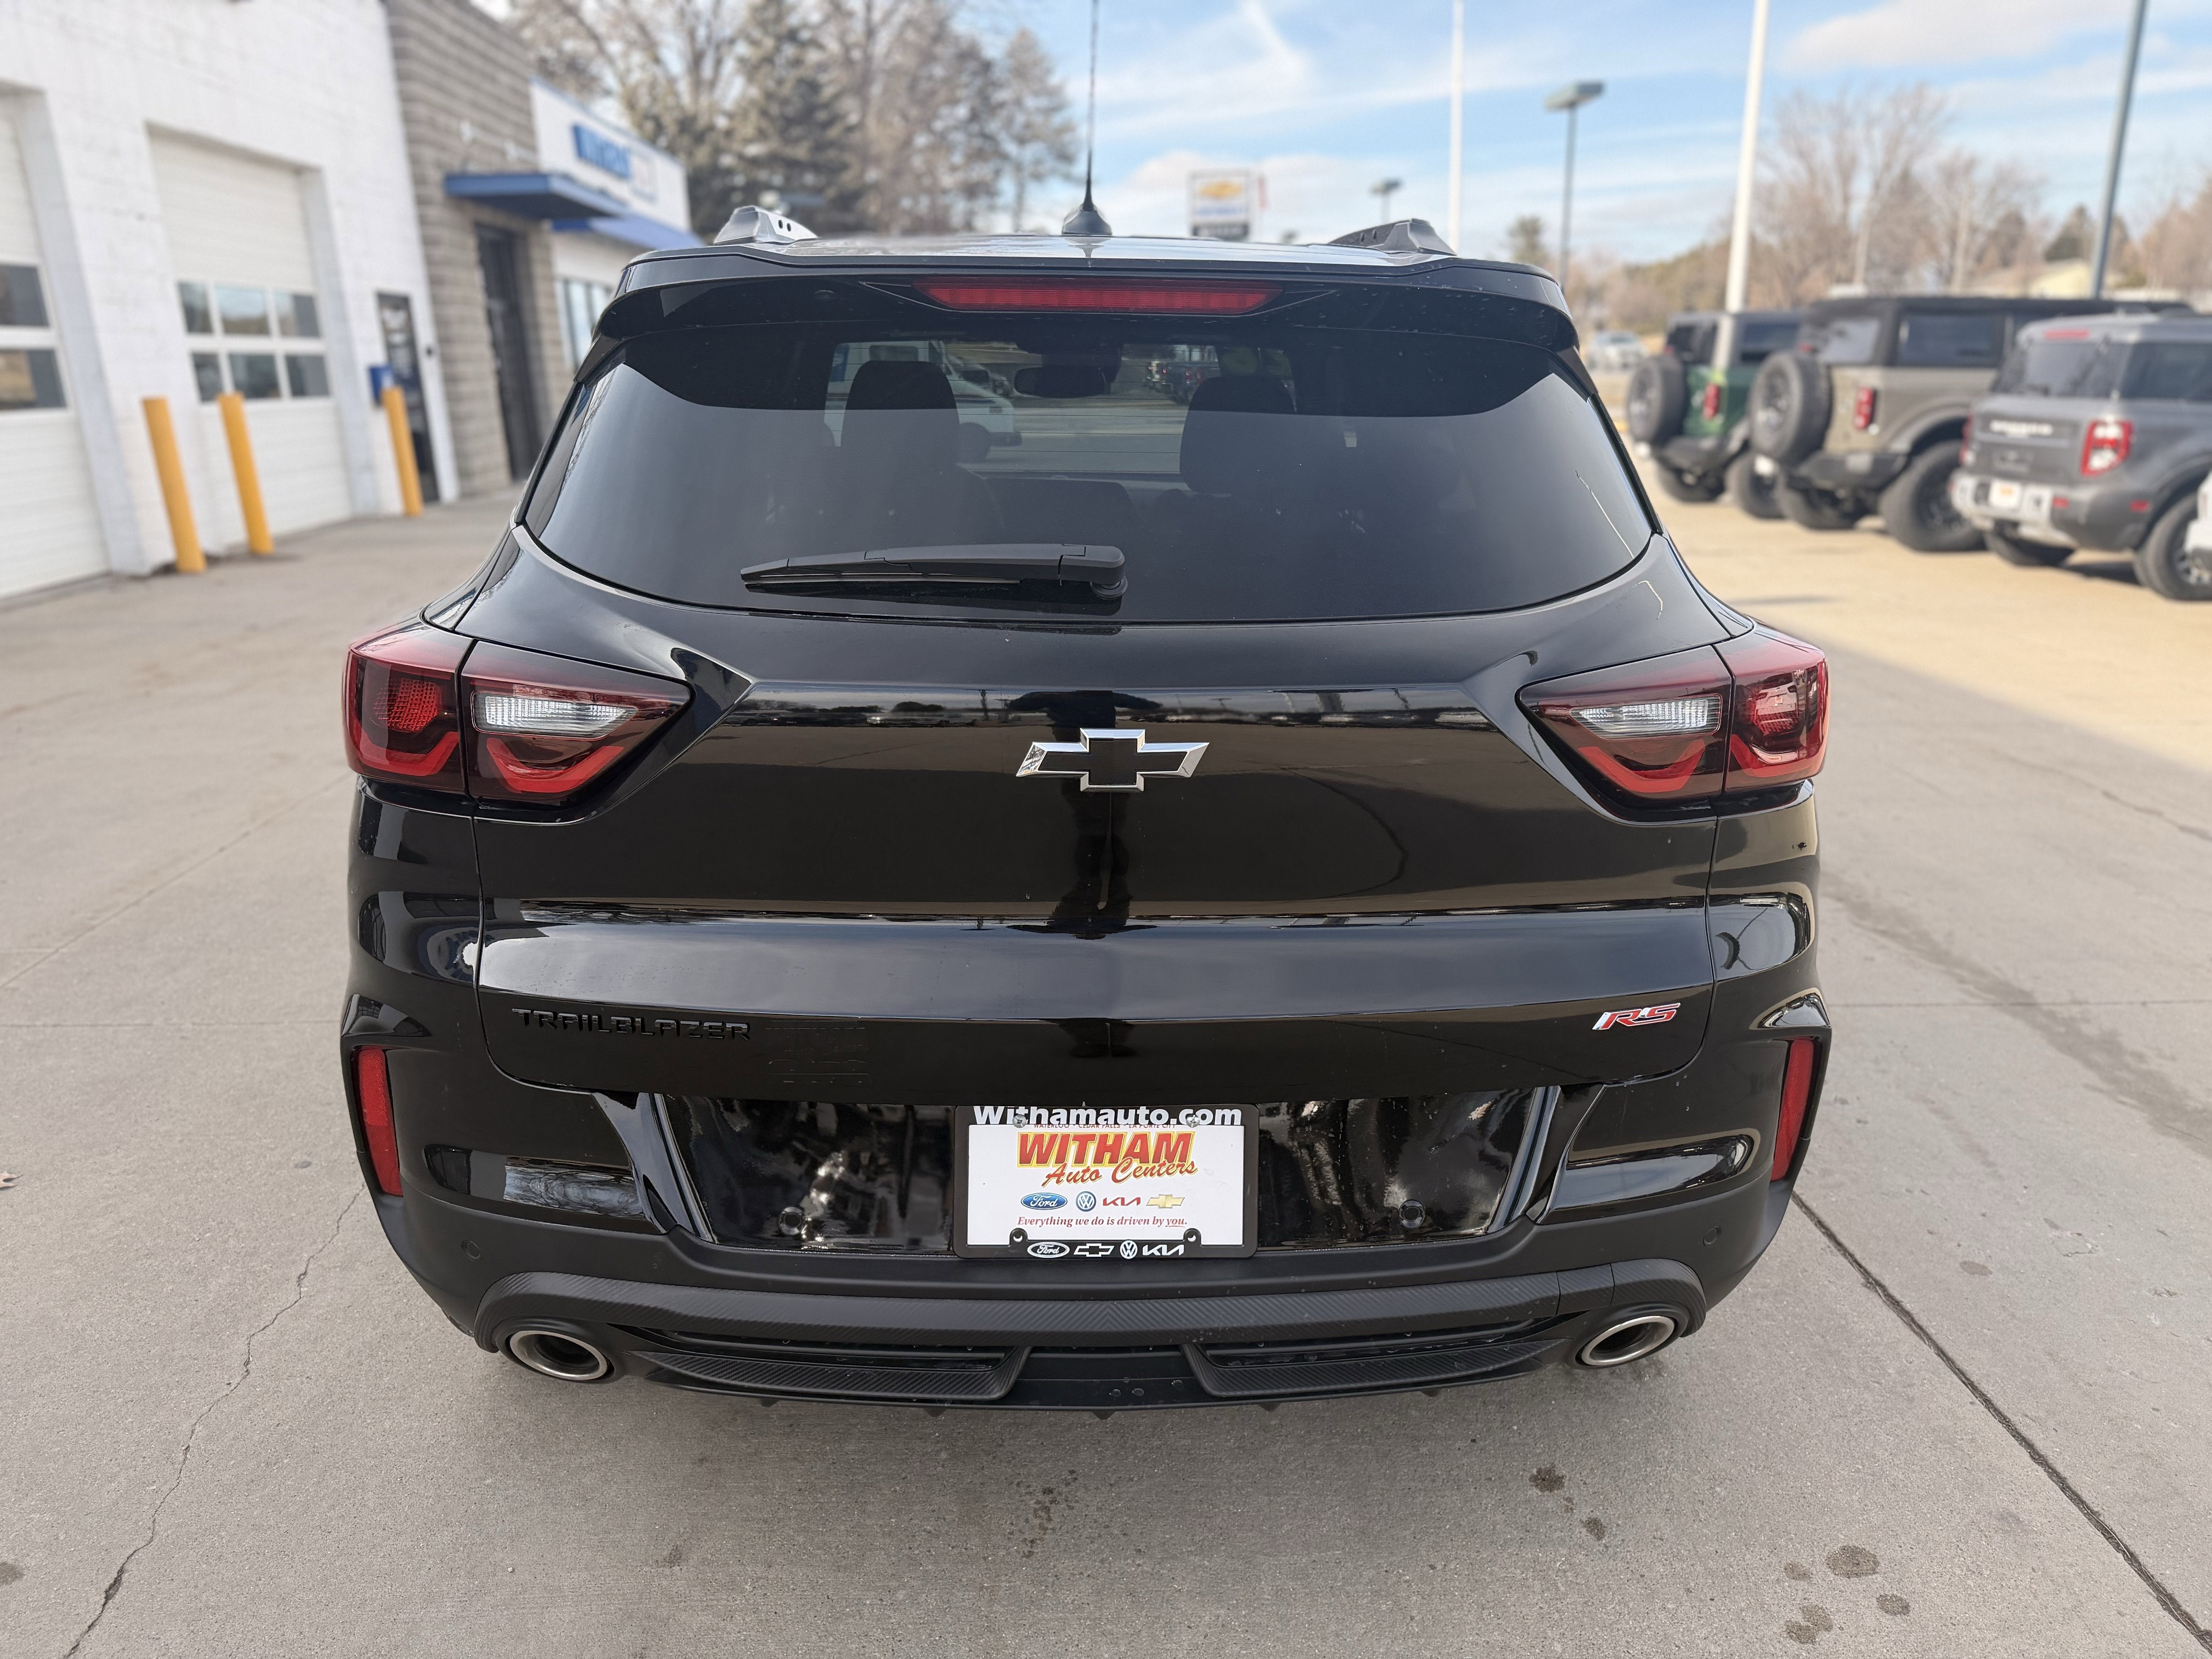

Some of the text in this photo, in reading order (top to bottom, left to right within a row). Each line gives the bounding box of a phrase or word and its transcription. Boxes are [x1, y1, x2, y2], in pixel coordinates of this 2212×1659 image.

[512, 1008, 750, 1041] TRAILBLAZER
[1592, 1003, 1681, 1030] RS
[1018, 1132, 1195, 1166] WITHAM
[1041, 1157, 1198, 1188] Auto Centers
[1030, 1195, 1059, 1207] Ford
[1103, 1197, 1141, 1206] KIA
[1017, 1216, 1074, 1228] Everything
[1091, 1216, 1104, 1225] do
[1107, 1216, 1115, 1225] is
[1117, 1216, 1150, 1225] driven
[1152, 1216, 1164, 1228] by
[1165, 1218, 1187, 1228] you.
[1142, 1244, 1185, 1256] KIA
